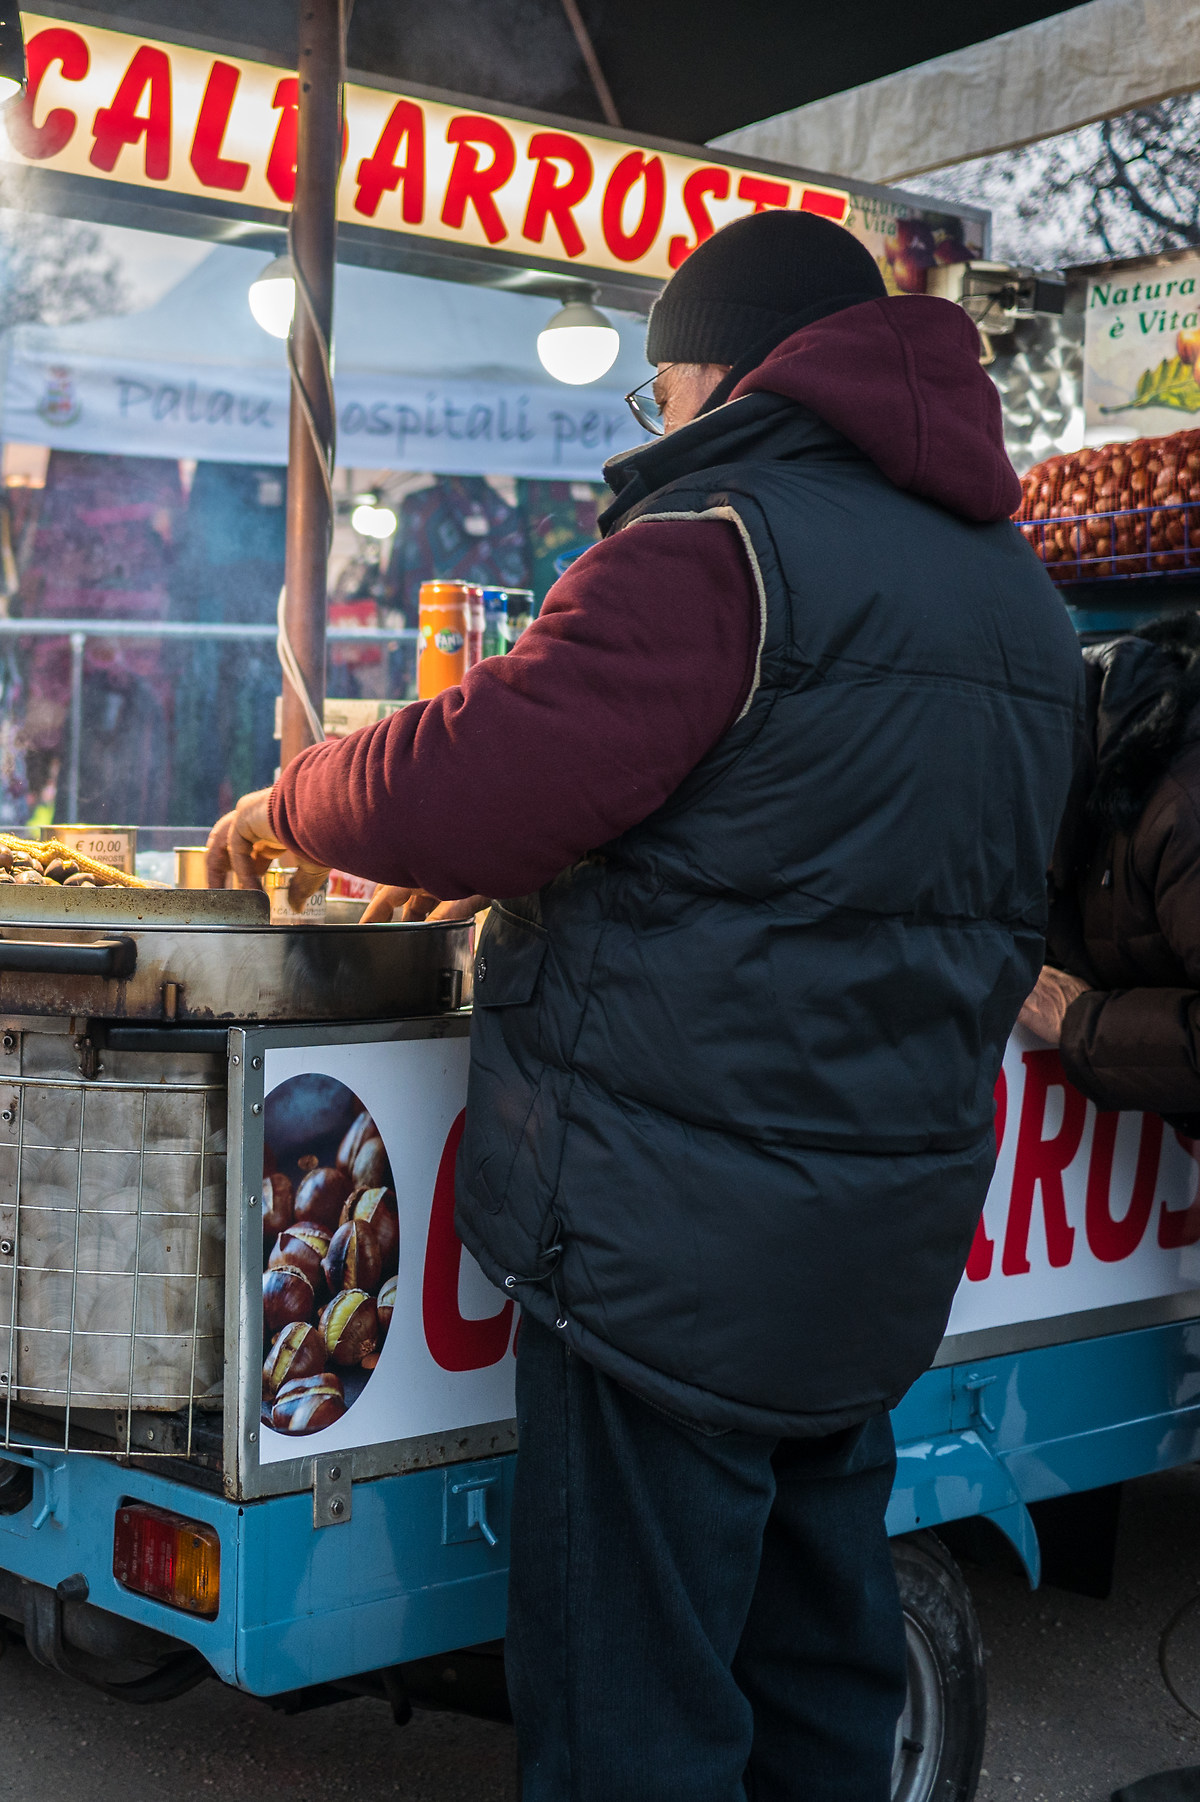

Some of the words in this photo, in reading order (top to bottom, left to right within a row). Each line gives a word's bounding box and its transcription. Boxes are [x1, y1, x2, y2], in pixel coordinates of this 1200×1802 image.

[1090, 278, 1196, 308] Natura
[1109, 315, 1124, 338] è
[1138, 309, 1198, 334] Vita
[339, 390, 538, 457] ospitali
